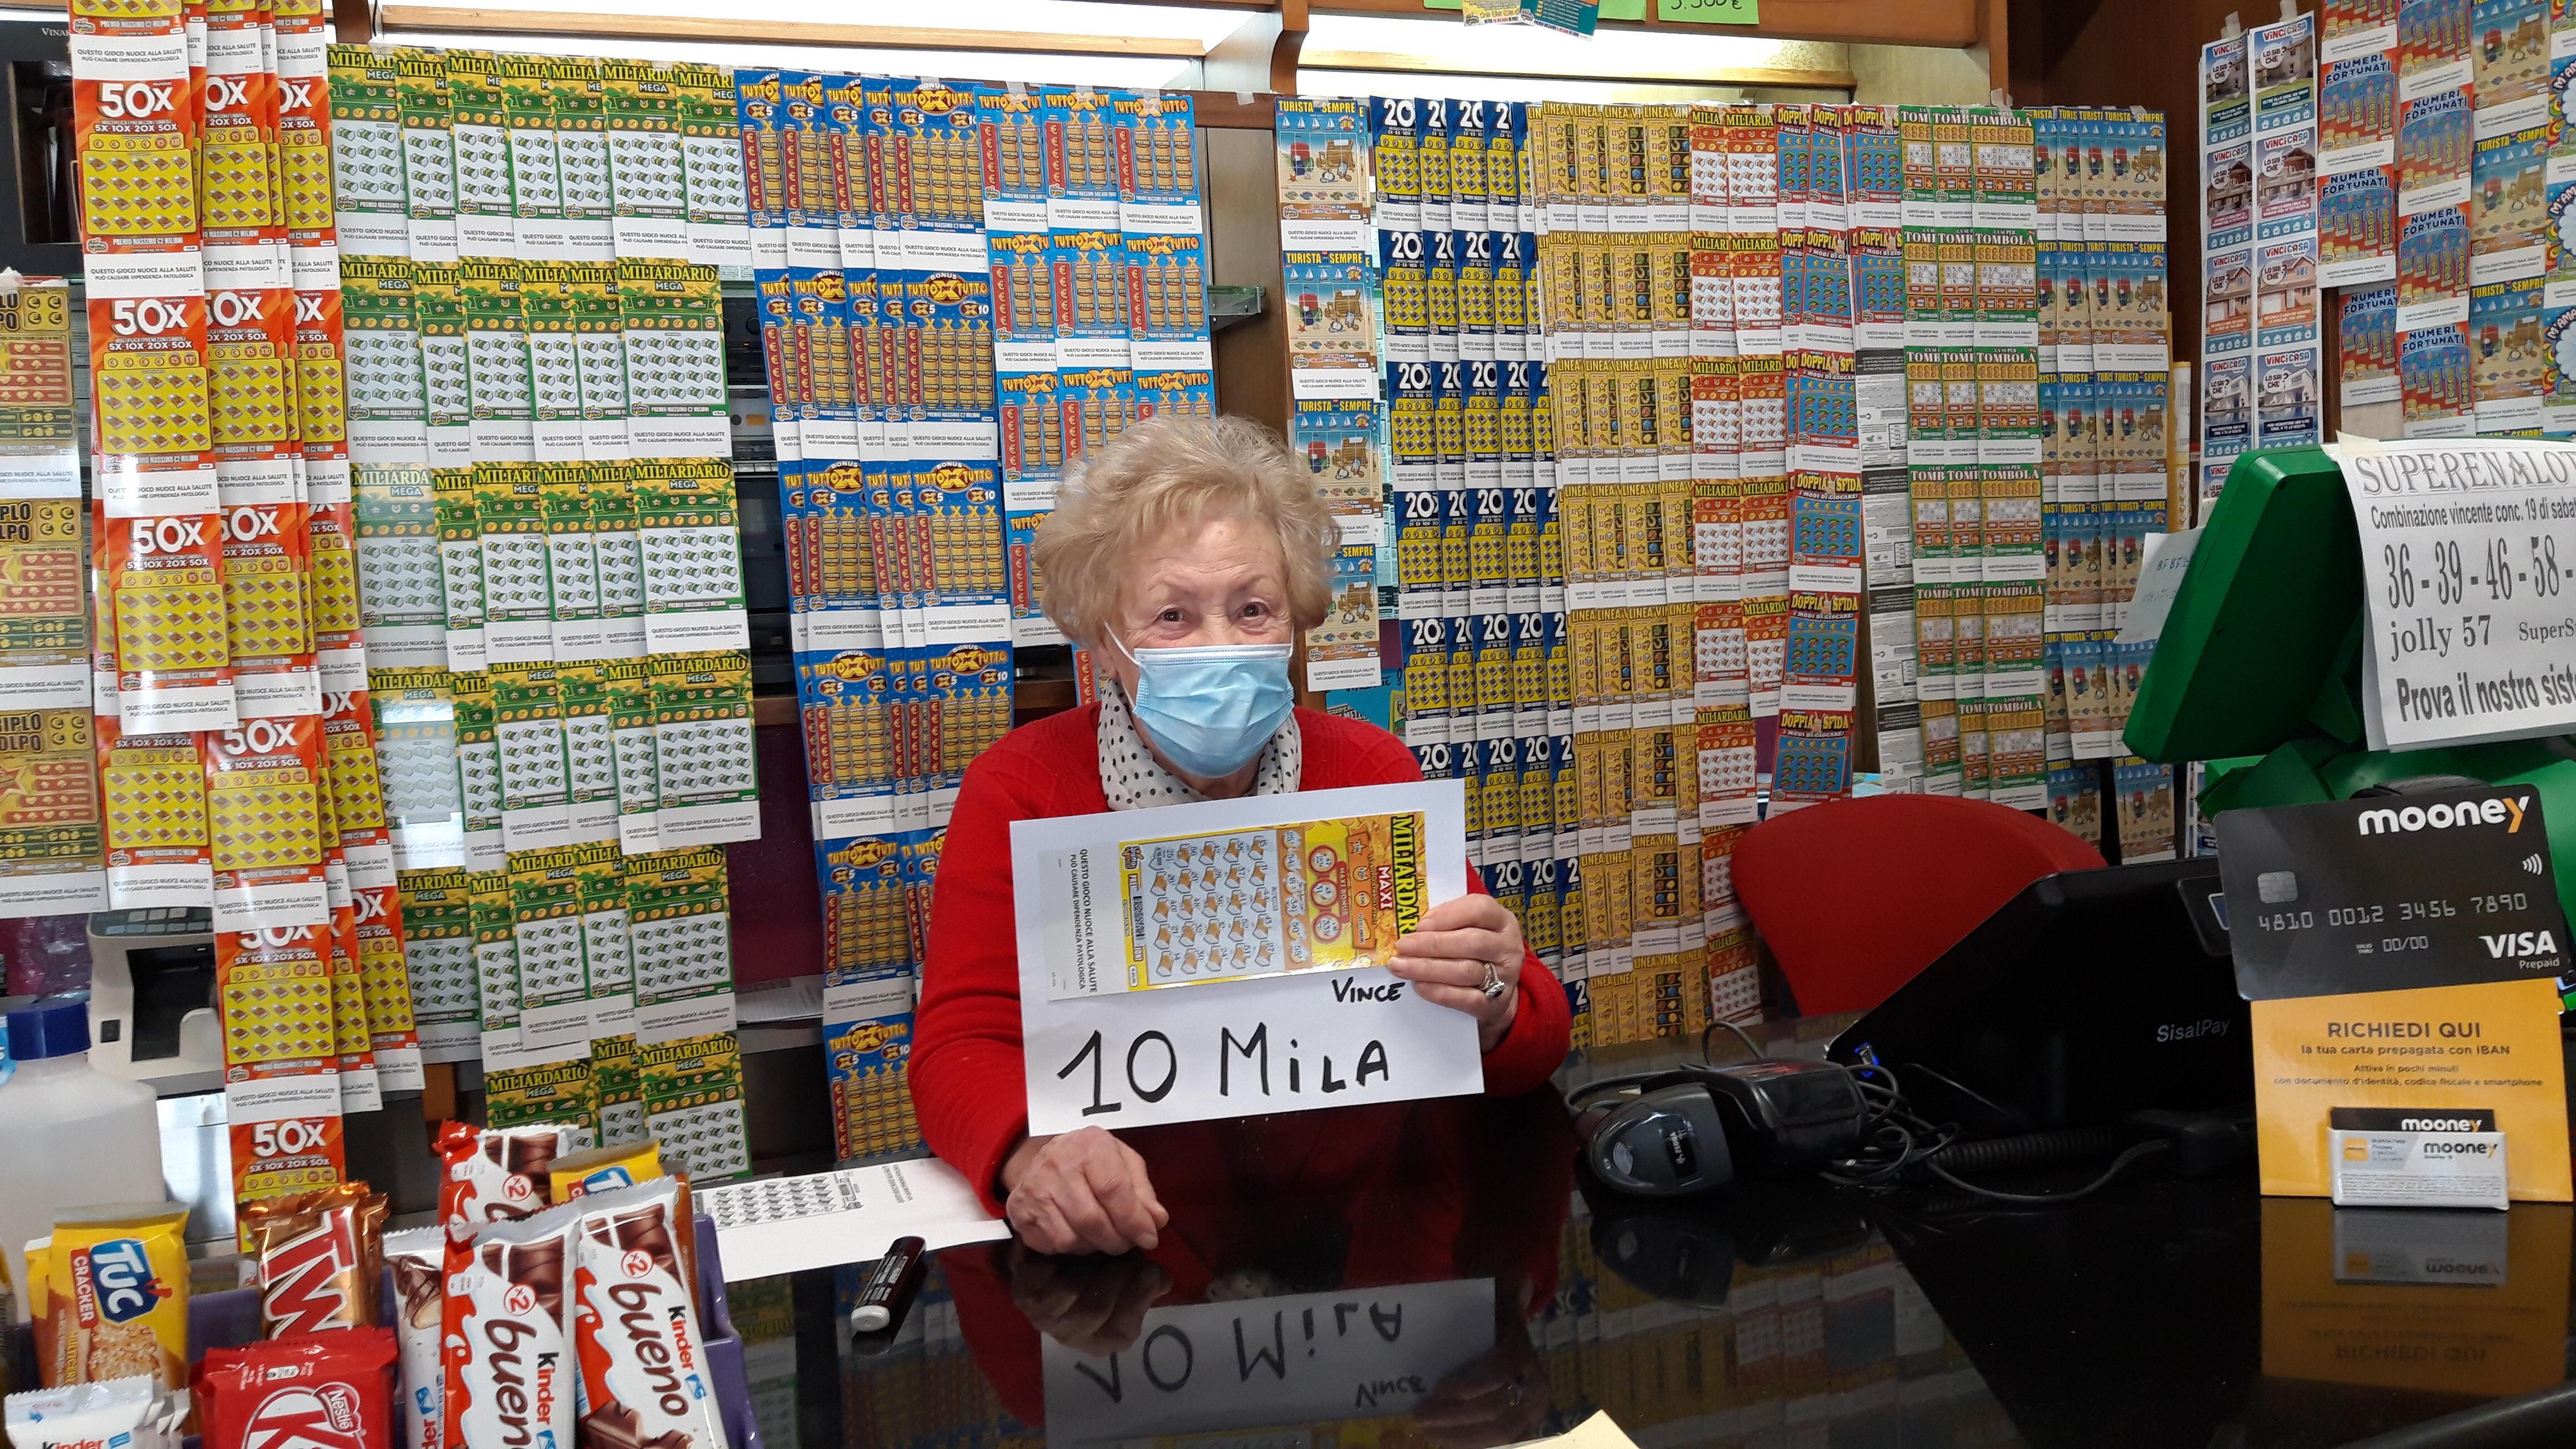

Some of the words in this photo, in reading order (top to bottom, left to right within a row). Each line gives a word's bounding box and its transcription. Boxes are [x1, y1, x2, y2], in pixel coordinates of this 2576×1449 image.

[2326, 61, 2390, 83] FORTUNATI
[2334, 54, 2383, 72] NUMERI
[638, 83, 667, 93] MEGA
[1278, 102, 1314, 114] TURISTA
[1322, 102, 1356, 113] SEMPRE
[1971, 115, 2032, 127] TOMBOLA
[2331, 169, 2379, 182] NUMERI
[2322, 177, 2388, 195] FORTUNATI
[1974, 235, 2034, 246] TOMBOLA
[1286, 252, 1322, 265] TURISTA
[1329, 252, 1363, 264] SEMPRE
[619, 264, 717, 282] MILIARDARIO
[655, 281, 683, 292] MEGA
[907, 283, 936, 297] TUTTO
[956, 282, 988, 294] TUTTO
[1977, 352, 2035, 364] TOMBOLA
[1298, 400, 1333, 413] TURISTA
[1339, 400, 1371, 413] SEMPRE
[634, 464, 731, 479] MILIARDARIO
[914, 472, 944, 486] TUTTO
[964, 470, 993, 484] TUTTO
[669, 480, 699, 489] MEGA
[2371, 504, 2448, 529] Combinazione
[2450, 501, 2493, 525] vincente
[2496, 504, 2523, 522] conc.
[2525, 498, 2536, 520] 19
[2540, 497, 2549, 519] di
[1342, 546, 1374, 558] SEMPRE
[2384, 543, 2415, 609] 36
[2435, 540, 2463, 605] 39
[2487, 537, 2512, 601] 46
[2531, 534, 2559, 598] 58
[2390, 616, 2452, 661] jolly
[2462, 614, 2490, 647] 57
[651, 656, 747, 676] MILIARDARIO
[686, 673, 714, 683] MEGA
[2396, 678, 2457, 722] Prova
[2457, 671, 2474, 716] il
[2476, 668, 2540, 713] nostro
[2358, 795, 2530, 835] mooney
[627, 850, 722, 877] MILIARDARIO
[1079, 849, 1088, 880] QUESTO
[1071, 869, 1079, 898] CAUSARE
[1082, 880, 1090, 907] GIOCO
[1377, 865, 1393, 910] MAXI
[1073, 899, 1082, 944] DIPENDENZA
[2258, 911, 2313, 931] 4810
[2329, 905, 2385, 927] 0012
[2400, 899, 2456, 920] 3456
[2470, 892, 2528, 914] 7890
[1085, 908, 1093, 938] NUOCE
[1086, 940, 1094, 960] ALLA
[2479, 930, 2557, 959] VISA
[1076, 944, 1086, 990] PATOLOGICA
[2519, 957, 2560, 970] Prepaid
[1088, 962, 1098, 993] SALUTE
[1331, 977, 1407, 1003] VINCE
[2156, 1019, 2230, 1043] SisalPay
[2328, 1021, 2429, 1038] RICHIEDI
[2438, 1021, 2480, 1038] QUI
[2301, 1045, 2312, 1054] la
[2316, 1046, 2337, 1054] tua
[2341, 1045, 2374, 1055] carta
[2378, 1045, 2444, 1056] prepagata
[2449, 1046, 2472, 1055] con
[2476, 1045, 2511, 1055] IBAN
[1056, 1029, 1178, 1118] 10
[2402, 1119, 2482, 1131] mooney
[2423, 1143, 2499, 1158] mooney
[92, 1243, 145, 1314] TUC
[73, 1256, 94, 1323] CRACKER
[608, 1282, 690, 1417] bueno
[485, 1319, 537, 1449] buen
